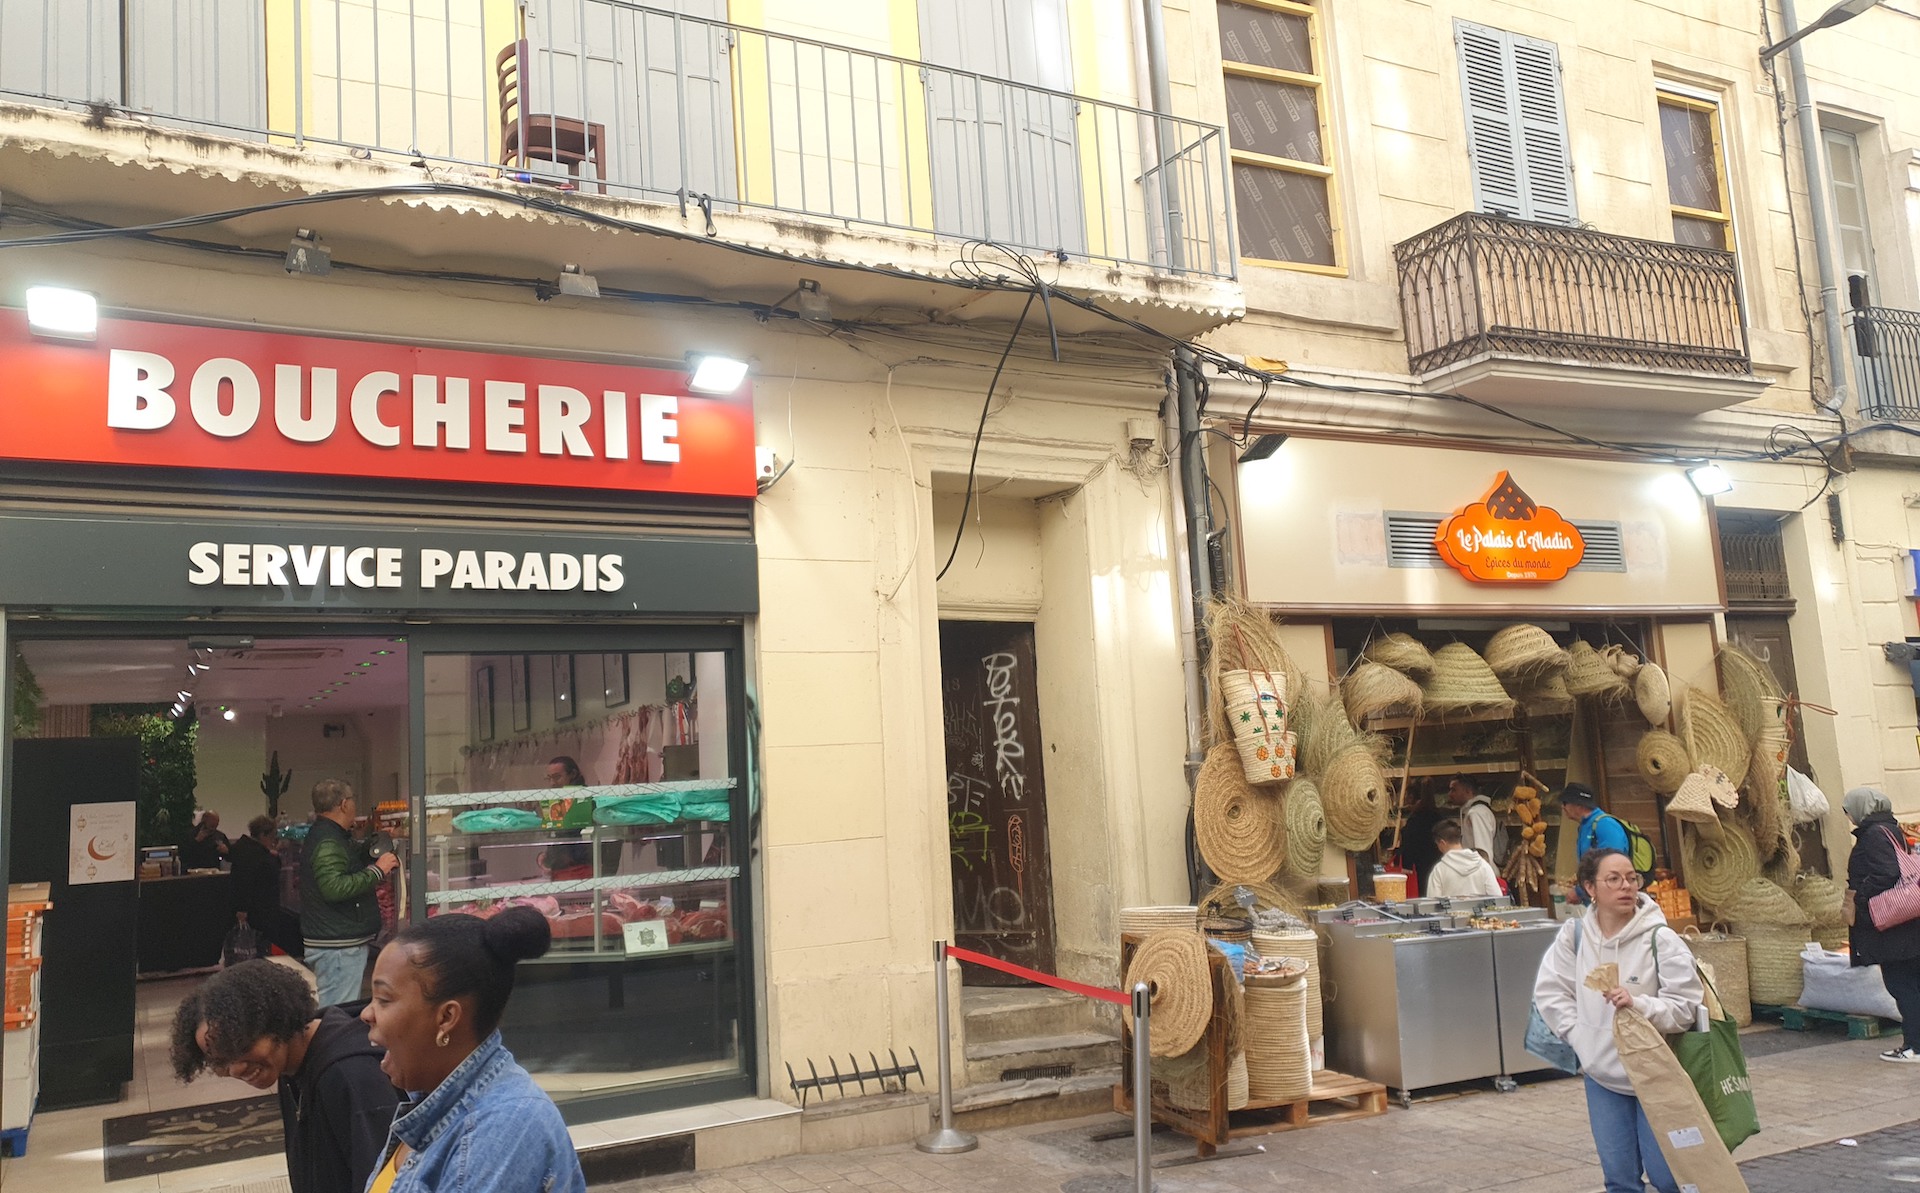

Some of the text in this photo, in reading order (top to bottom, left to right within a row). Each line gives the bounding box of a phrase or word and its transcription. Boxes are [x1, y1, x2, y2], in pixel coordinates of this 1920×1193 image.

[108, 349, 680, 463] BOUCHERIE
[1457, 526, 1574, 552] Le Palais d'Aladin
[188, 541, 625, 593] SERVICE PARADIS
[1513, 557, 1524, 569] du
[1525, 559, 1551, 569] monde
